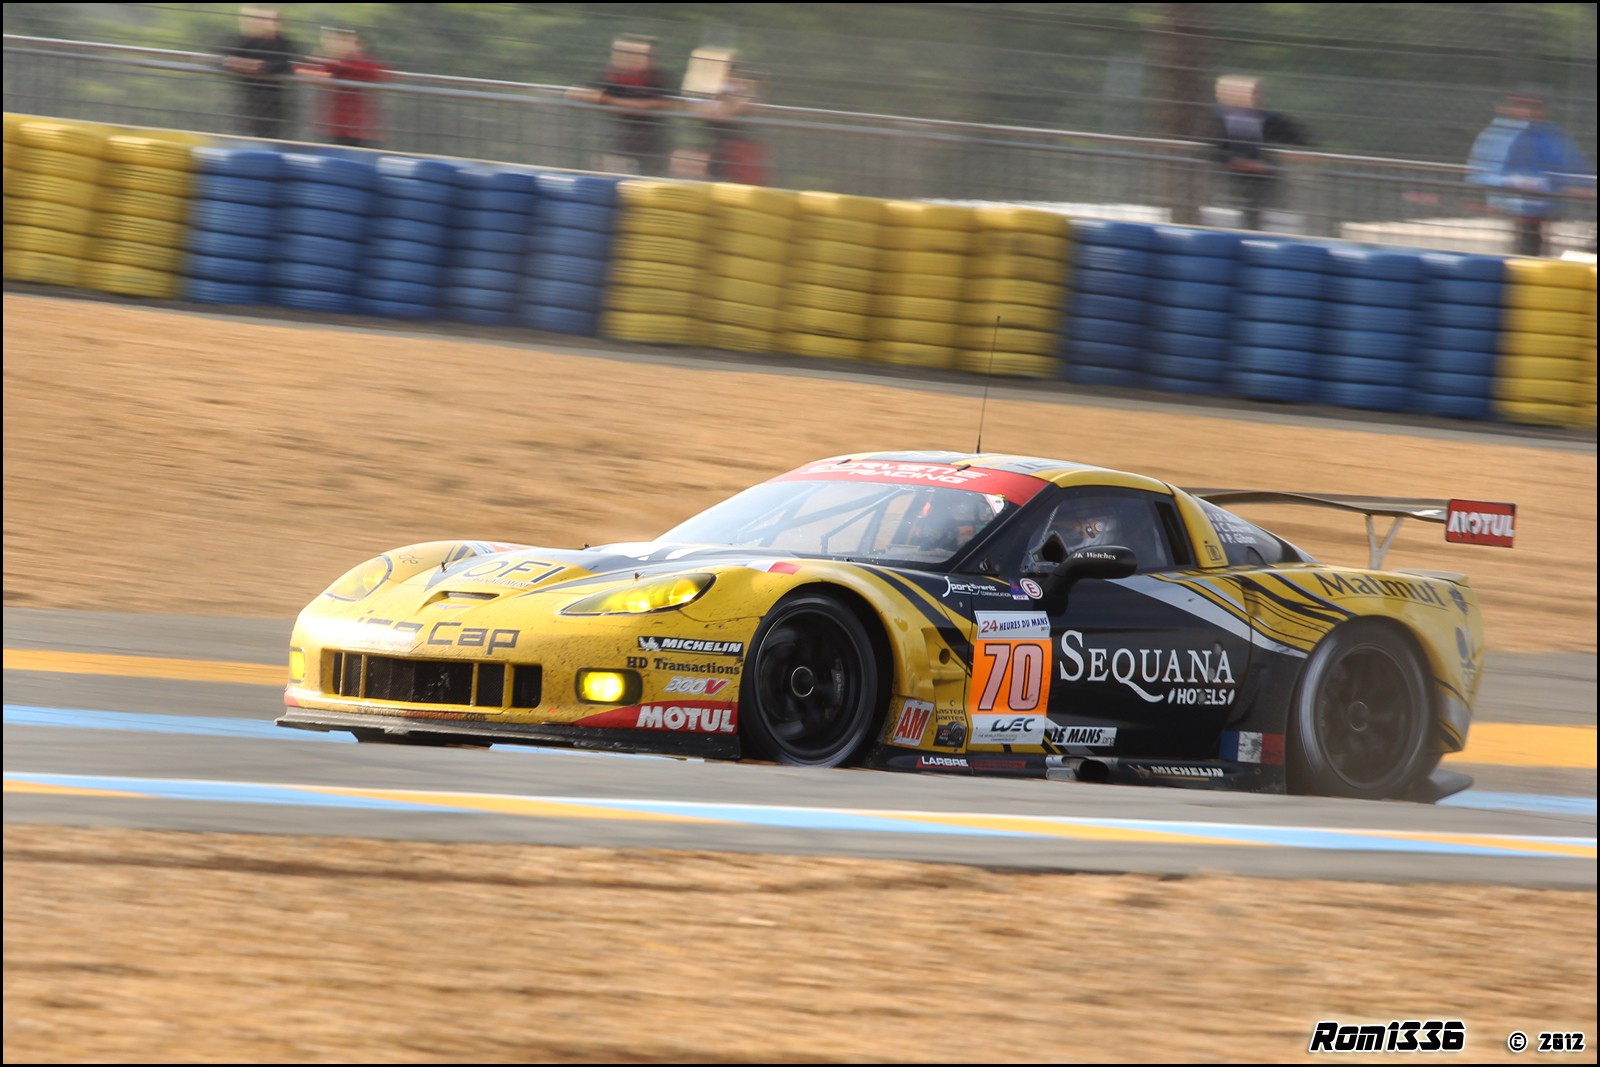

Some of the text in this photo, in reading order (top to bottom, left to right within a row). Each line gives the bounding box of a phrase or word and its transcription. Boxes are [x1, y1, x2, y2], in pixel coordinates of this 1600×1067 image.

[848, 470, 969, 484] RACING
[1448, 510, 1515, 537] MOTUL
[1086, 551, 1117, 560] Watches
[462, 560, 567, 584] OFI
[1312, 572, 1446, 607] Matmut
[981, 616, 1048, 634] 24 HEURES DU MANS
[427, 621, 521, 655] Cap
[660, 638, 742, 653] MICHELIN
[626, 656, 740, 675] HD Transactions
[1059, 629, 1236, 703] SEQUANA
[663, 676, 731, 695] 300V
[977, 643, 1044, 711] 70
[636, 705, 736, 733] MOTUL
[895, 706, 931, 740] AM
[991, 717, 1036, 732] WEC
[1051, 726, 1067, 743] LE
[1066, 728, 1102, 744] MANS
[920, 756, 969, 767] LARBRE
[1150, 765, 1224, 778] MICHELIN
